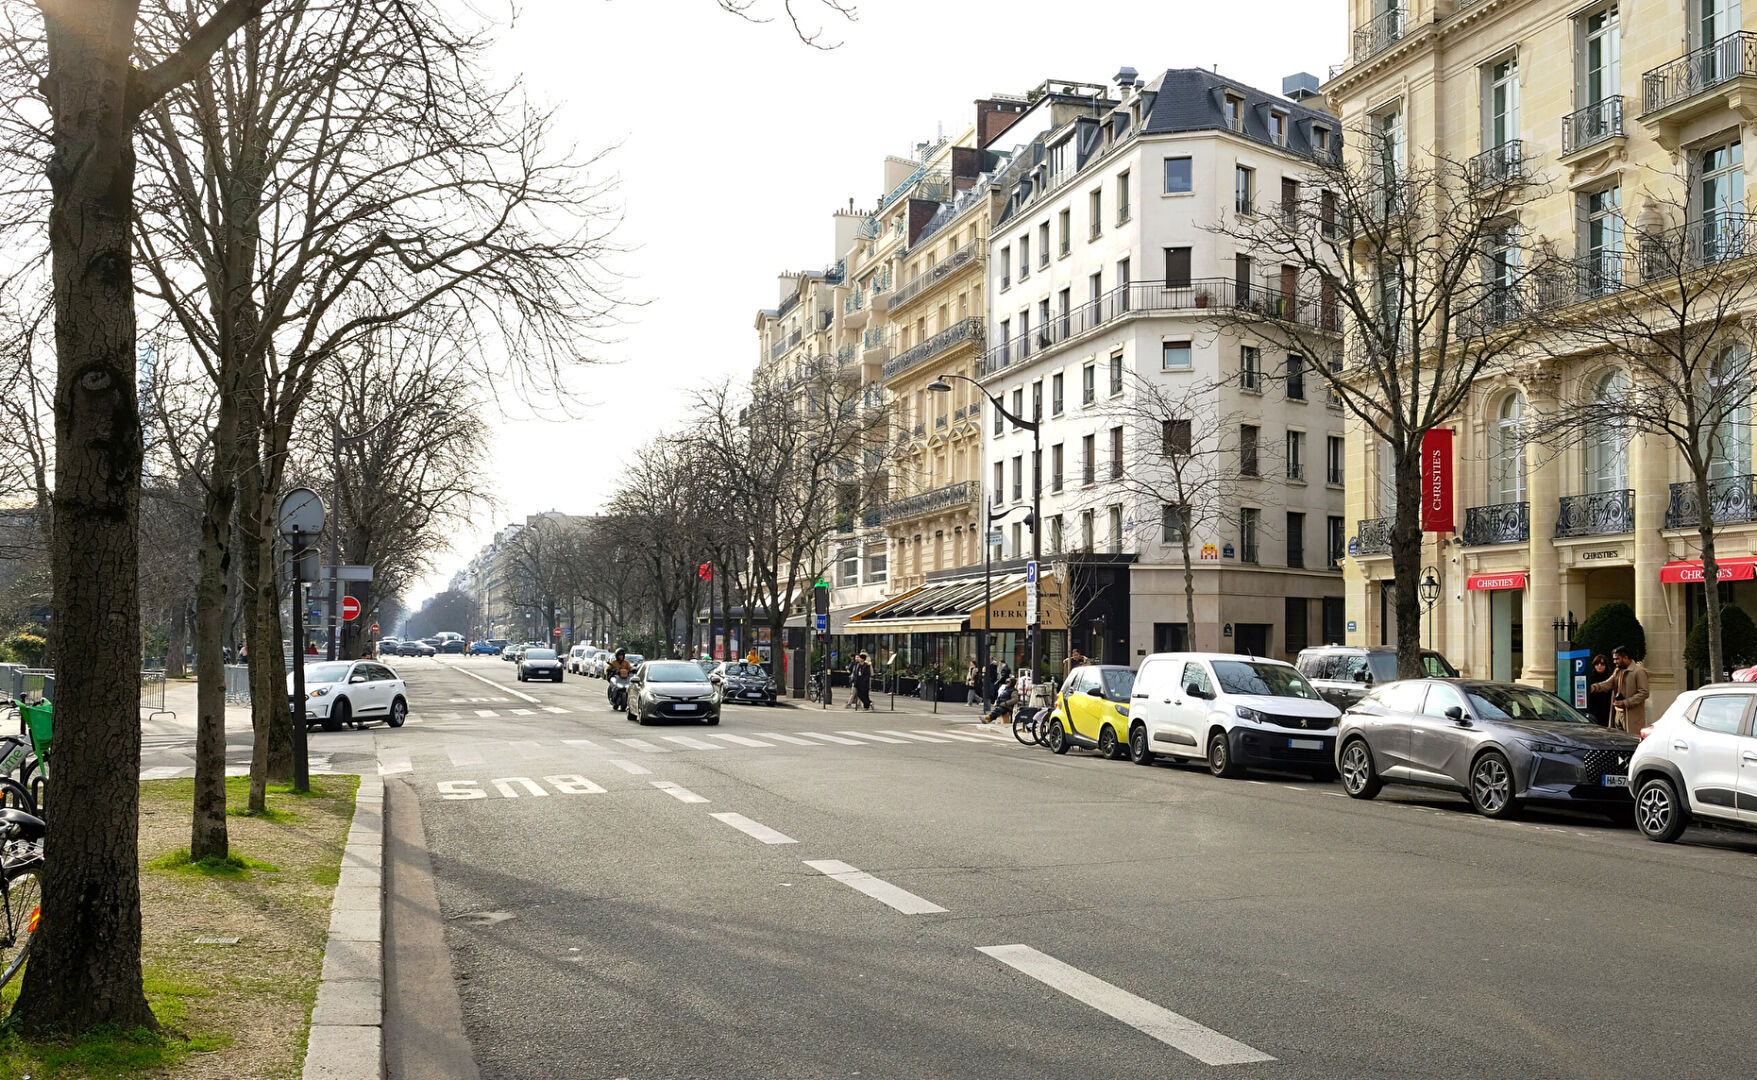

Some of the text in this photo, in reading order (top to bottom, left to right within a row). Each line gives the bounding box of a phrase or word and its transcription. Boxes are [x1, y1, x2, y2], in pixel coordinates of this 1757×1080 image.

[1432, 449, 1442, 511] CHRISTIE'S
[1029, 566, 1034, 580] P
[1477, 578, 1513, 588] CHRISTIE'S
[1575, 659, 1583, 672] P
[0, 749, 23, 773] ime
[436, 774, 608, 800] BUS
